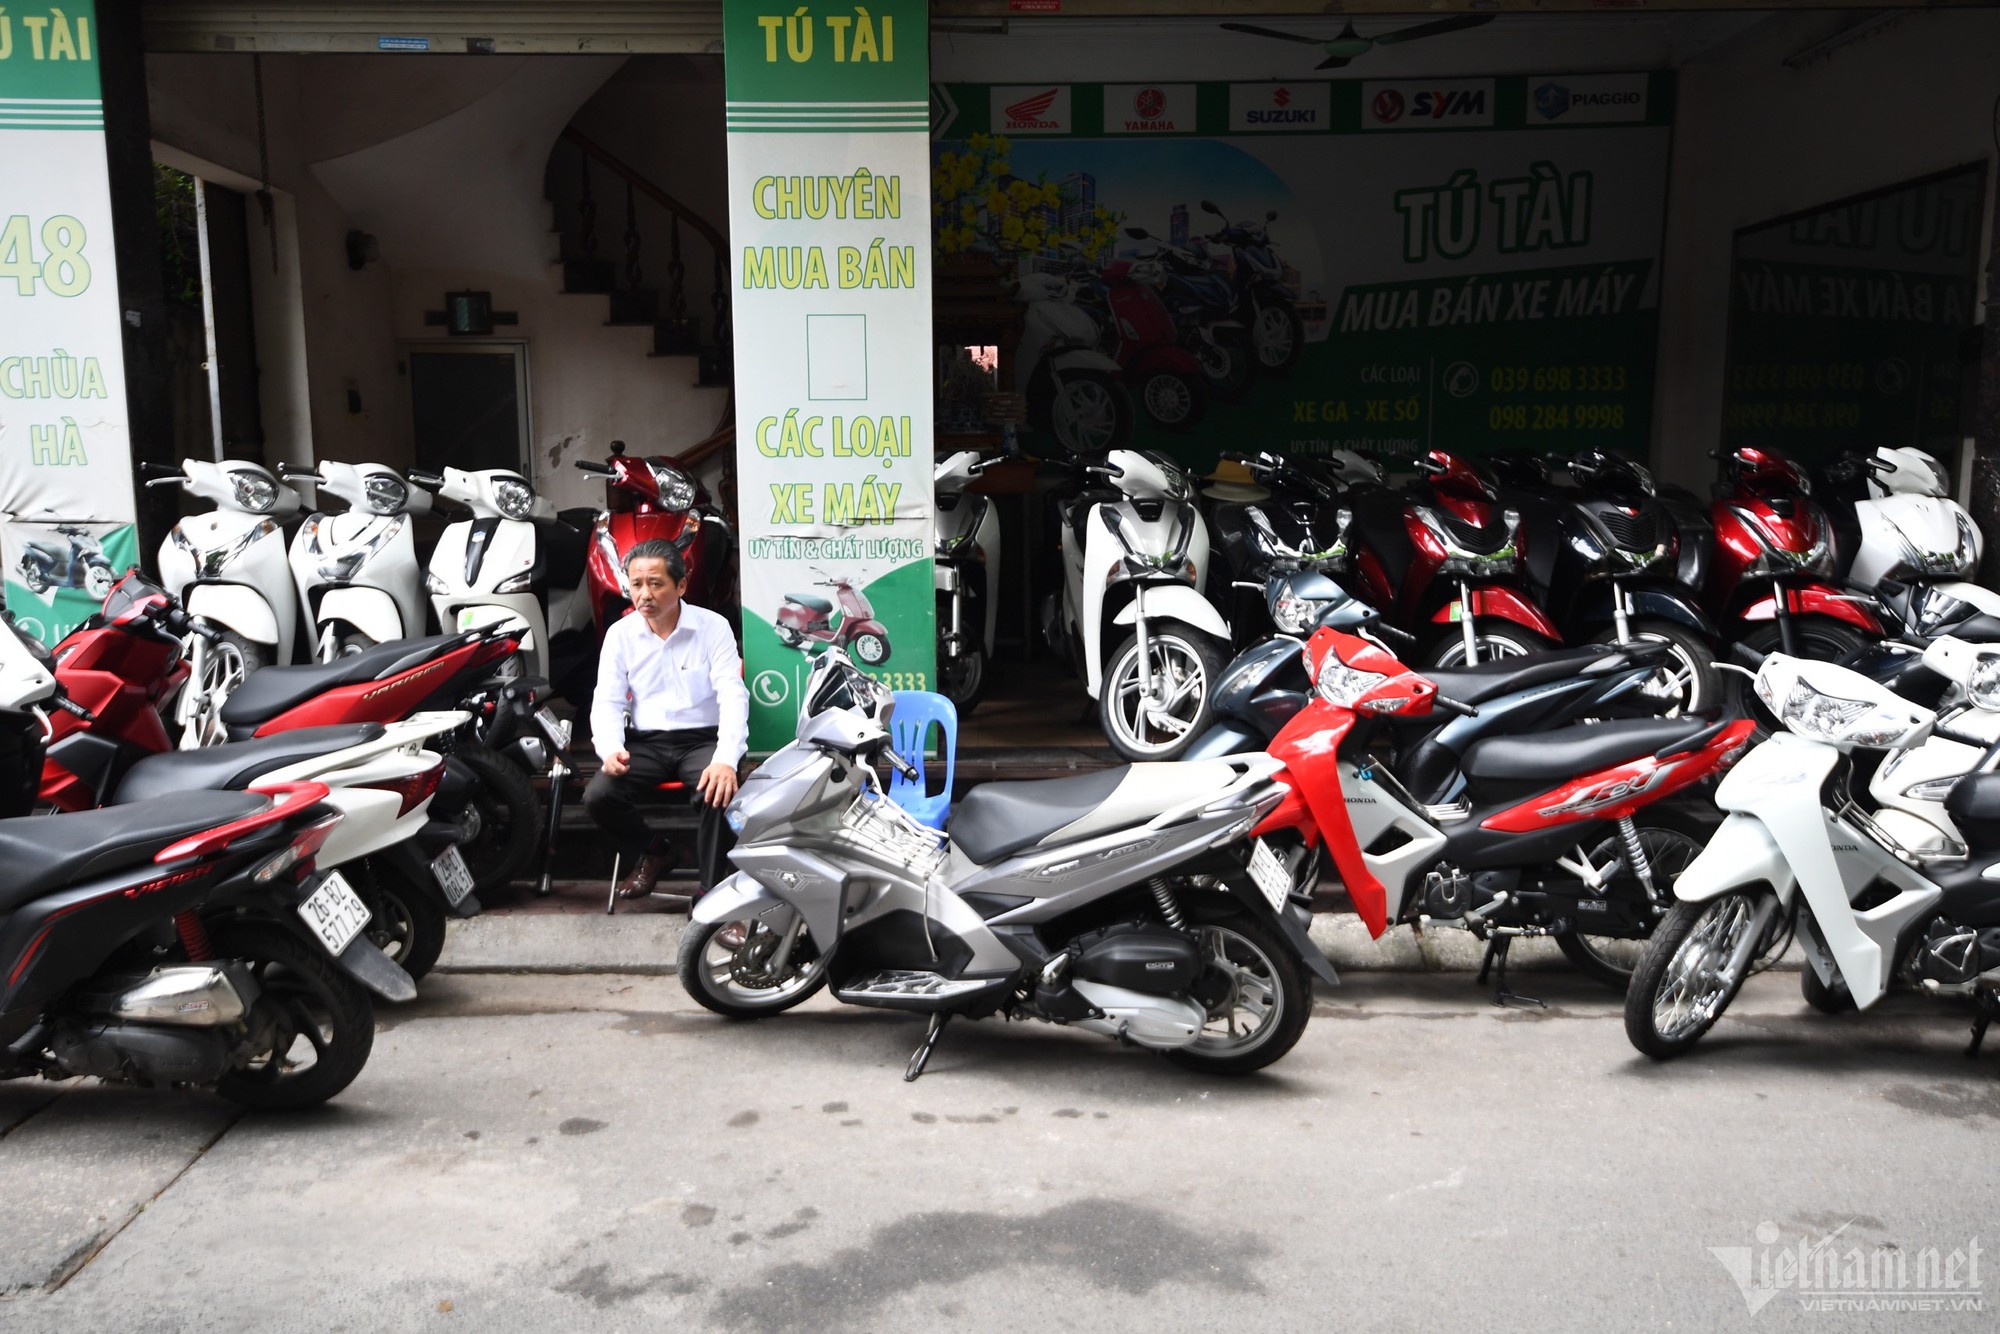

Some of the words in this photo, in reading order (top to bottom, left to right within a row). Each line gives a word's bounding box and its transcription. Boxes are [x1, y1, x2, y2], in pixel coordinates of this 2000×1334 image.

[22, 7, 92, 61] TÀI
[758, 7, 814, 63] TÚ
[826, 7, 894, 63] TÀI
[1246, 109, 1316, 125] SUZUKI
[1410, 90, 1485, 119] SYM
[1571, 91, 1640, 106] PIAGGIO
[1006, 119, 1060, 130] HONDA
[1124, 120, 1175, 131] YAMAHA
[752, 167, 901, 220] CHUYÊN
[1394, 168, 1481, 264] TÚ
[1489, 160, 1594, 254] TÀI
[0, 214, 92, 298] 48
[742, 245, 829, 290] MUA
[837, 237, 915, 290] BÁN
[1340, 288, 1419, 333] MUA
[1427, 276, 1503, 327] BÁN
[1504, 279, 1550, 322] XE
[1553, 266, 1637, 318] MÁY
[0, 348, 108, 399] CHÙA
[1360, 362, 1388, 384] CÁC
[1391, 365, 1421, 387] LOẠI
[1490, 366, 1528, 392] 039
[1533, 366, 1571, 392] 698
[1575, 366, 1627, 392] 3333
[1293, 400, 1317, 423] XE
[1321, 399, 1349, 423] GA
[1364, 399, 1389, 423] XE
[1394, 393, 1421, 422] SỐ
[1488, 405, 1528, 431] 098
[1531, 404, 1569, 430] 284
[1574, 404, 1626, 430] 9998
[30, 416, 88, 466] HÀ
[756, 408, 824, 458] CÁC
[832, 415, 912, 469] LOẠI
[1290, 440, 1307, 453] UY
[770, 483, 814, 525] XE
[823, 474, 902, 525] MÁY
[748, 538, 774, 560] UY
[774, 536, 803, 559] TÍN
[803, 539, 819, 560] &
[820, 535, 866, 559] CHẤT
[866, 538, 924, 564] LƯỢNG
[308, 880, 347, 924] 26-B2
[322, 898, 367, 949] 577.29
